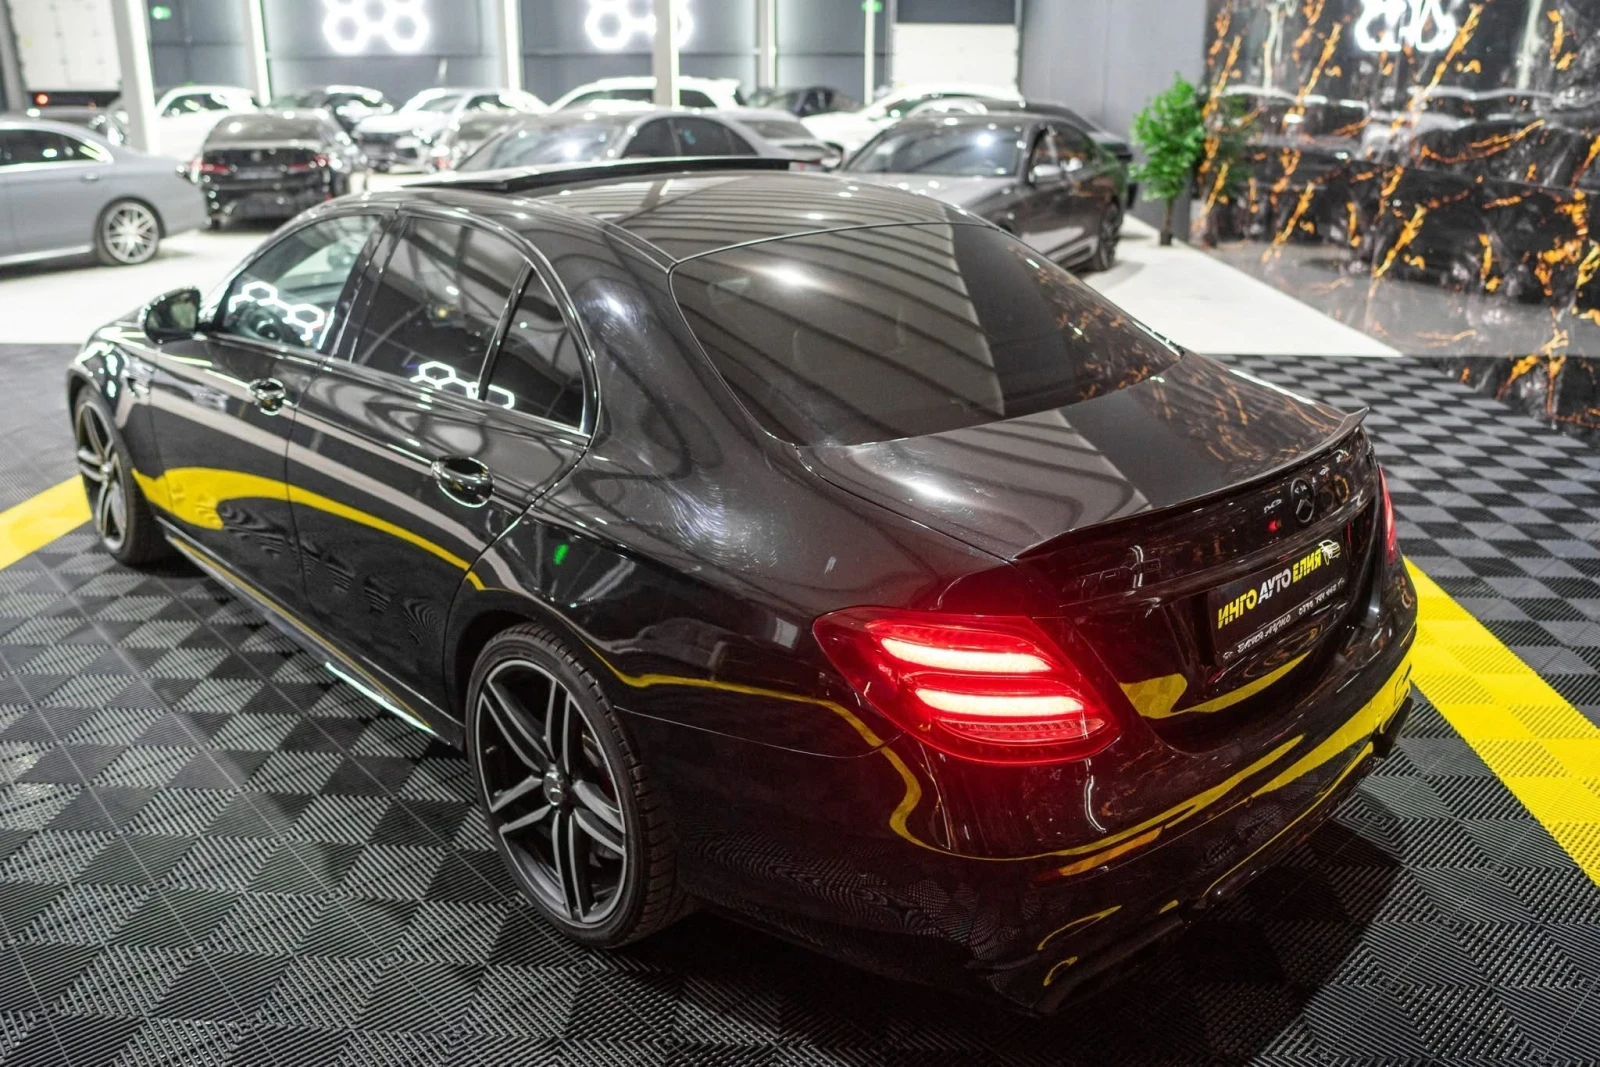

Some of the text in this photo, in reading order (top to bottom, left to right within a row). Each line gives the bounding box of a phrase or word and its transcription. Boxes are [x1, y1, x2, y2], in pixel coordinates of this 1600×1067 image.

[1218, 589, 1258, 630] ИНГО
[1258, 568, 1291, 604] АУТО
[1292, 548, 1322, 583] ЕЛИЯ
